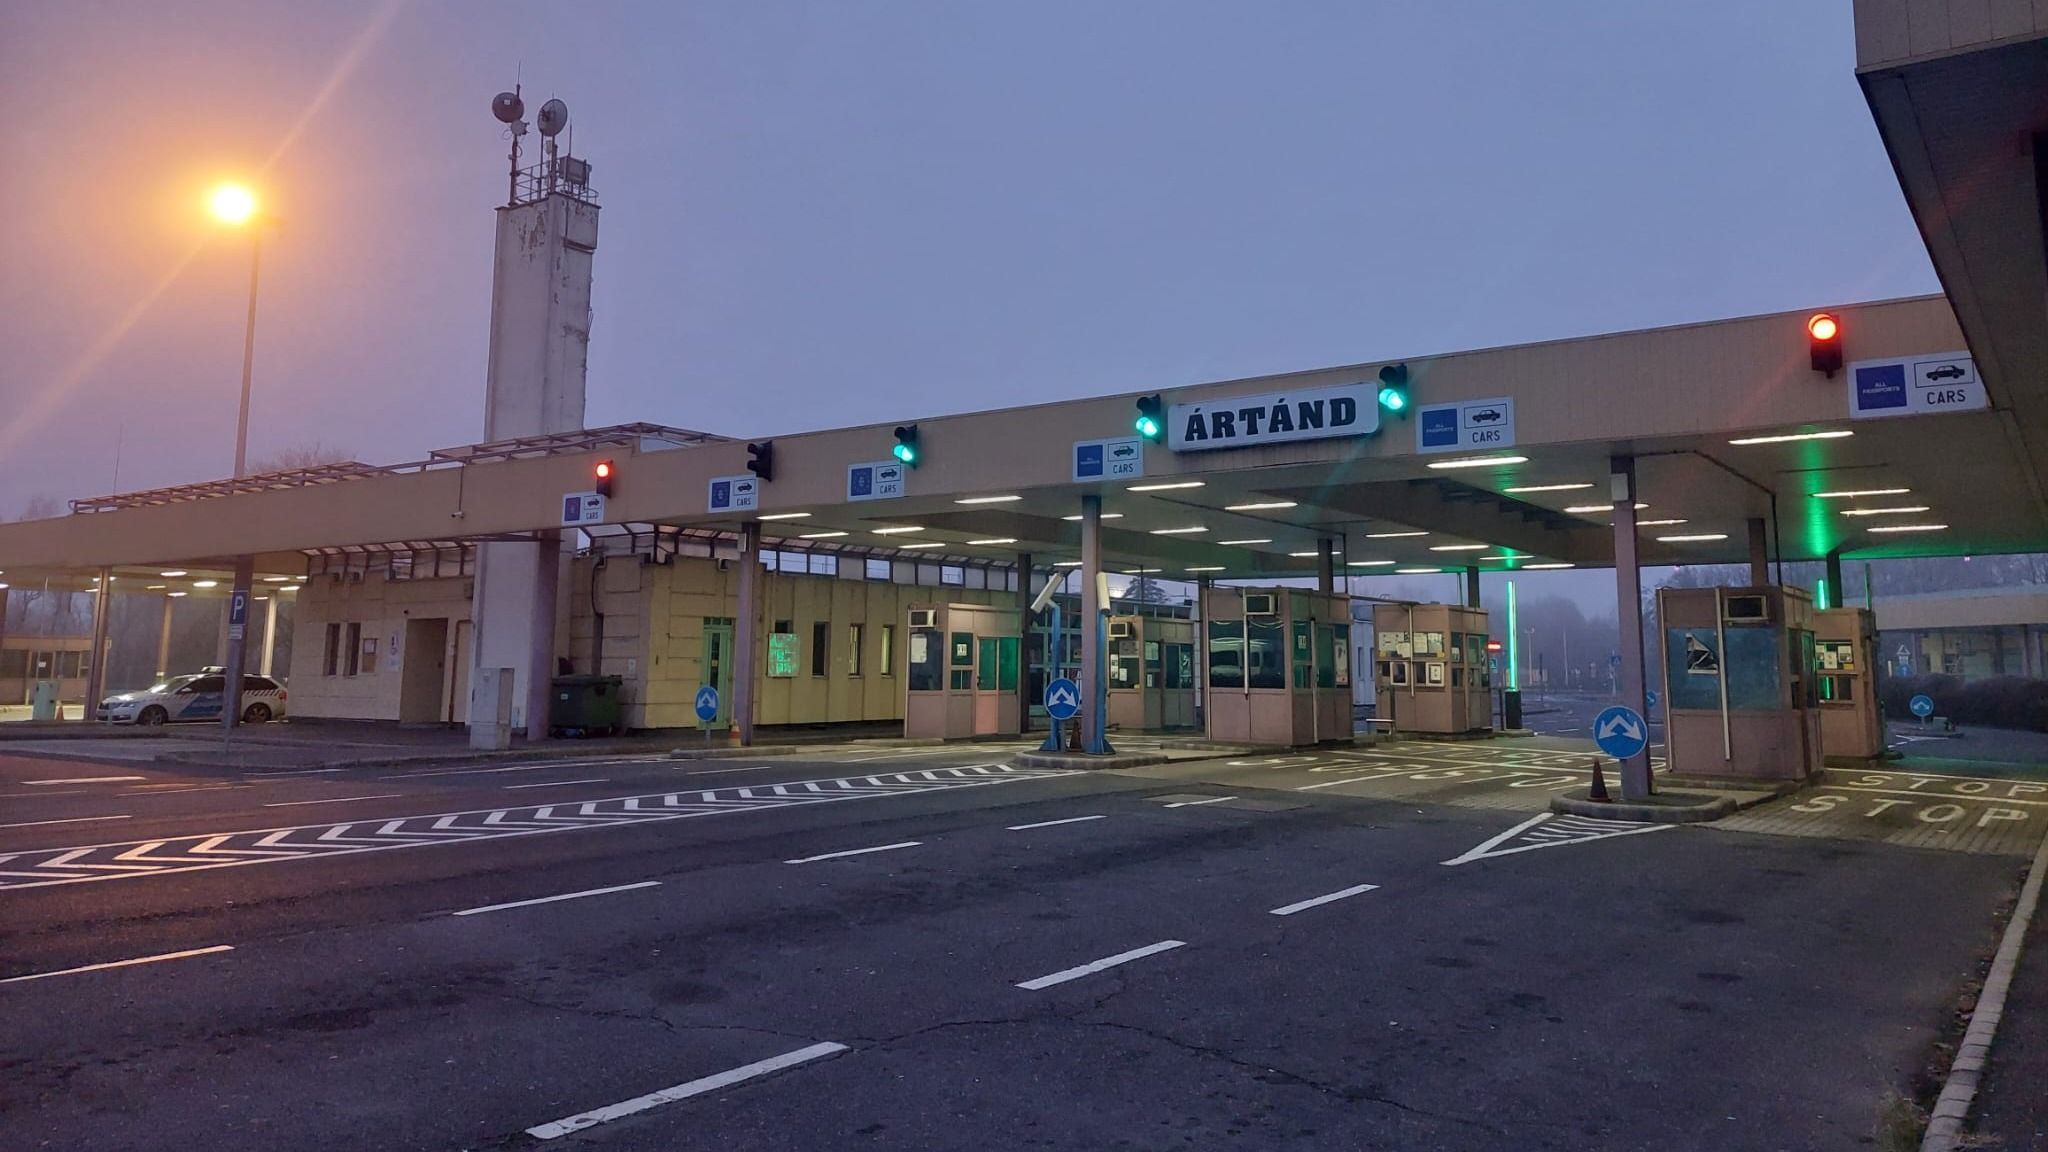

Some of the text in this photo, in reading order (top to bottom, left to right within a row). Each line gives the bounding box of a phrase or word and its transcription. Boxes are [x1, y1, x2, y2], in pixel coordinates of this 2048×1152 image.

[1926, 389, 1966, 405] CARS
[1185, 398, 1356, 441] ÁRTÁND
[1472, 430, 1500, 443] CARS
[1113, 463, 1133, 474] CARS
[880, 484, 896, 494] CARS
[233, 596, 244, 620] P
[1226, 756, 1431, 773] STOP
[1849, 775, 2047, 797] STOP
[1791, 796, 2029, 827] STOP
